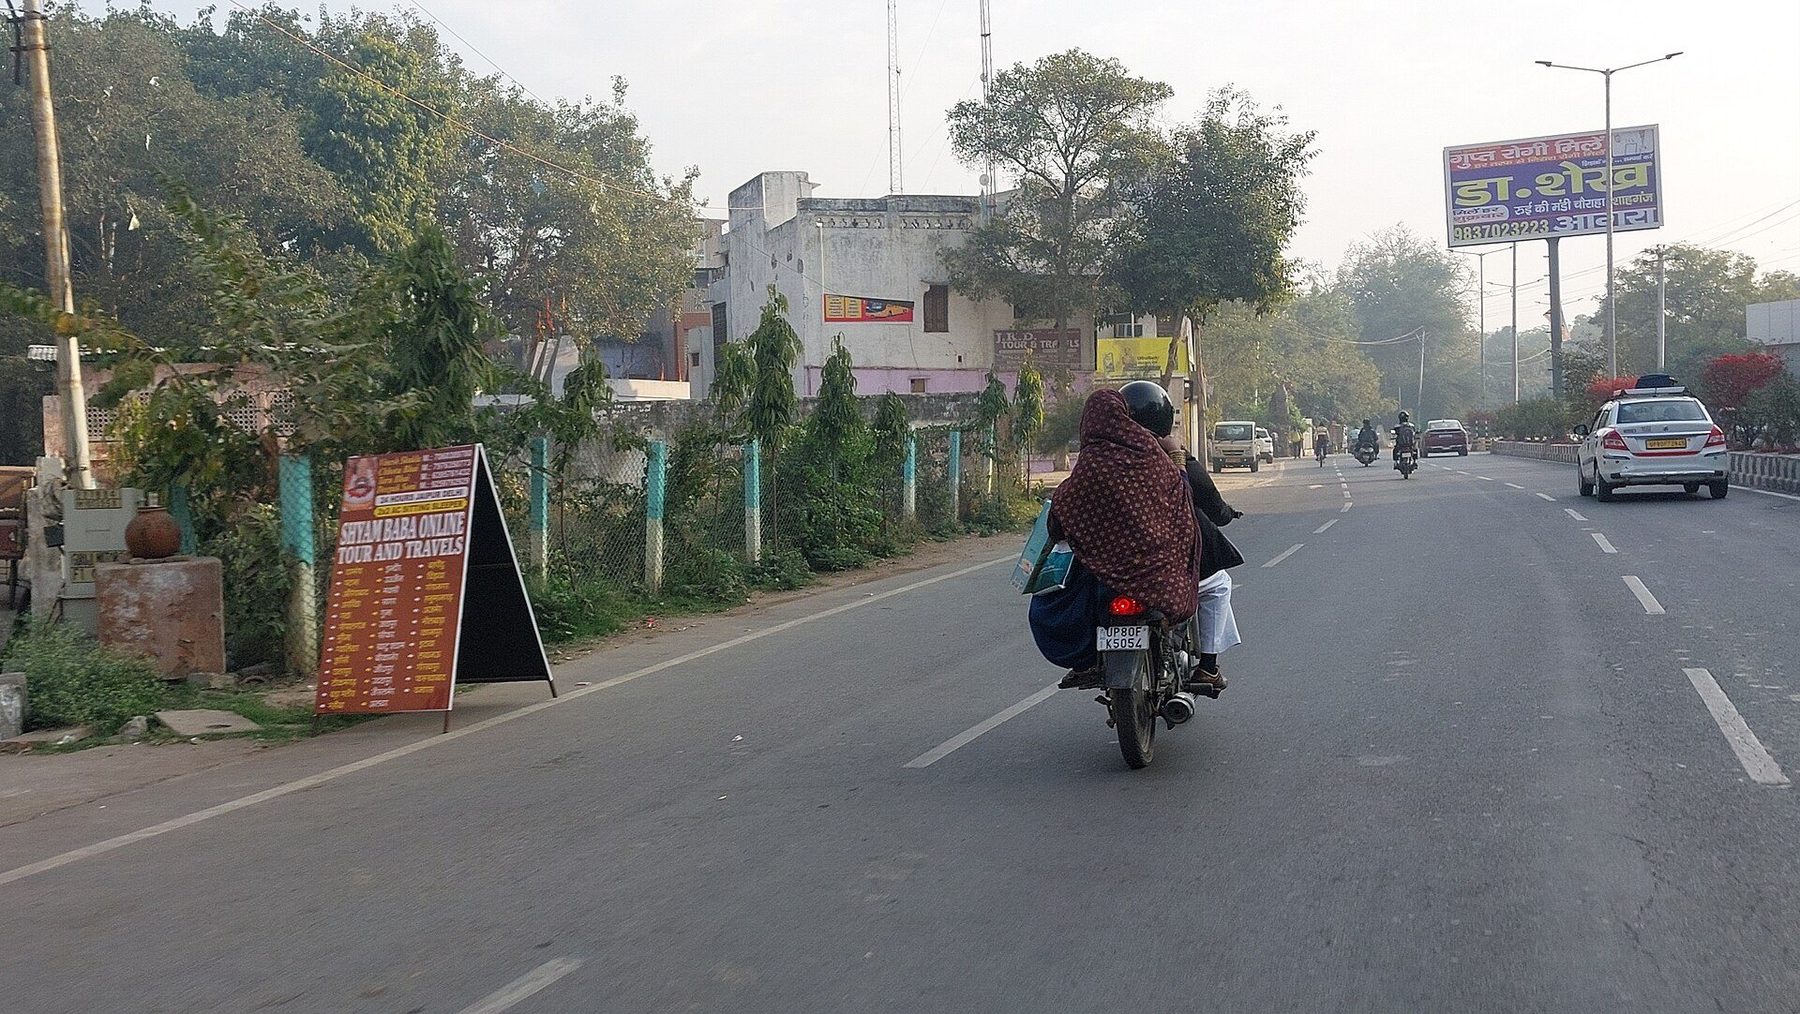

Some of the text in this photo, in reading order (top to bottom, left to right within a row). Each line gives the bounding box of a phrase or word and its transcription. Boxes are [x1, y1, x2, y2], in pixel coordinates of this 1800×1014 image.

[1450, 135, 1606, 169] गुप्त रोगी मिलें
[1534, 200, 1550, 213] की
[1551, 197, 1572, 212] मंडी
[1612, 191, 1655, 206] शाहगंज
[1454, 219, 1550, 240] 9837023223
[1554, 207, 1659, 231] आगरा
[1001, 341, 1027, 350] TOUR
[340, 512, 465, 545] SHYAM BABA ONLINE
[337, 537, 463, 564] TOUR AND TRAVELS
[1106, 627, 1142, 638] UP80F
[1106, 638, 1142, 649] K5054
